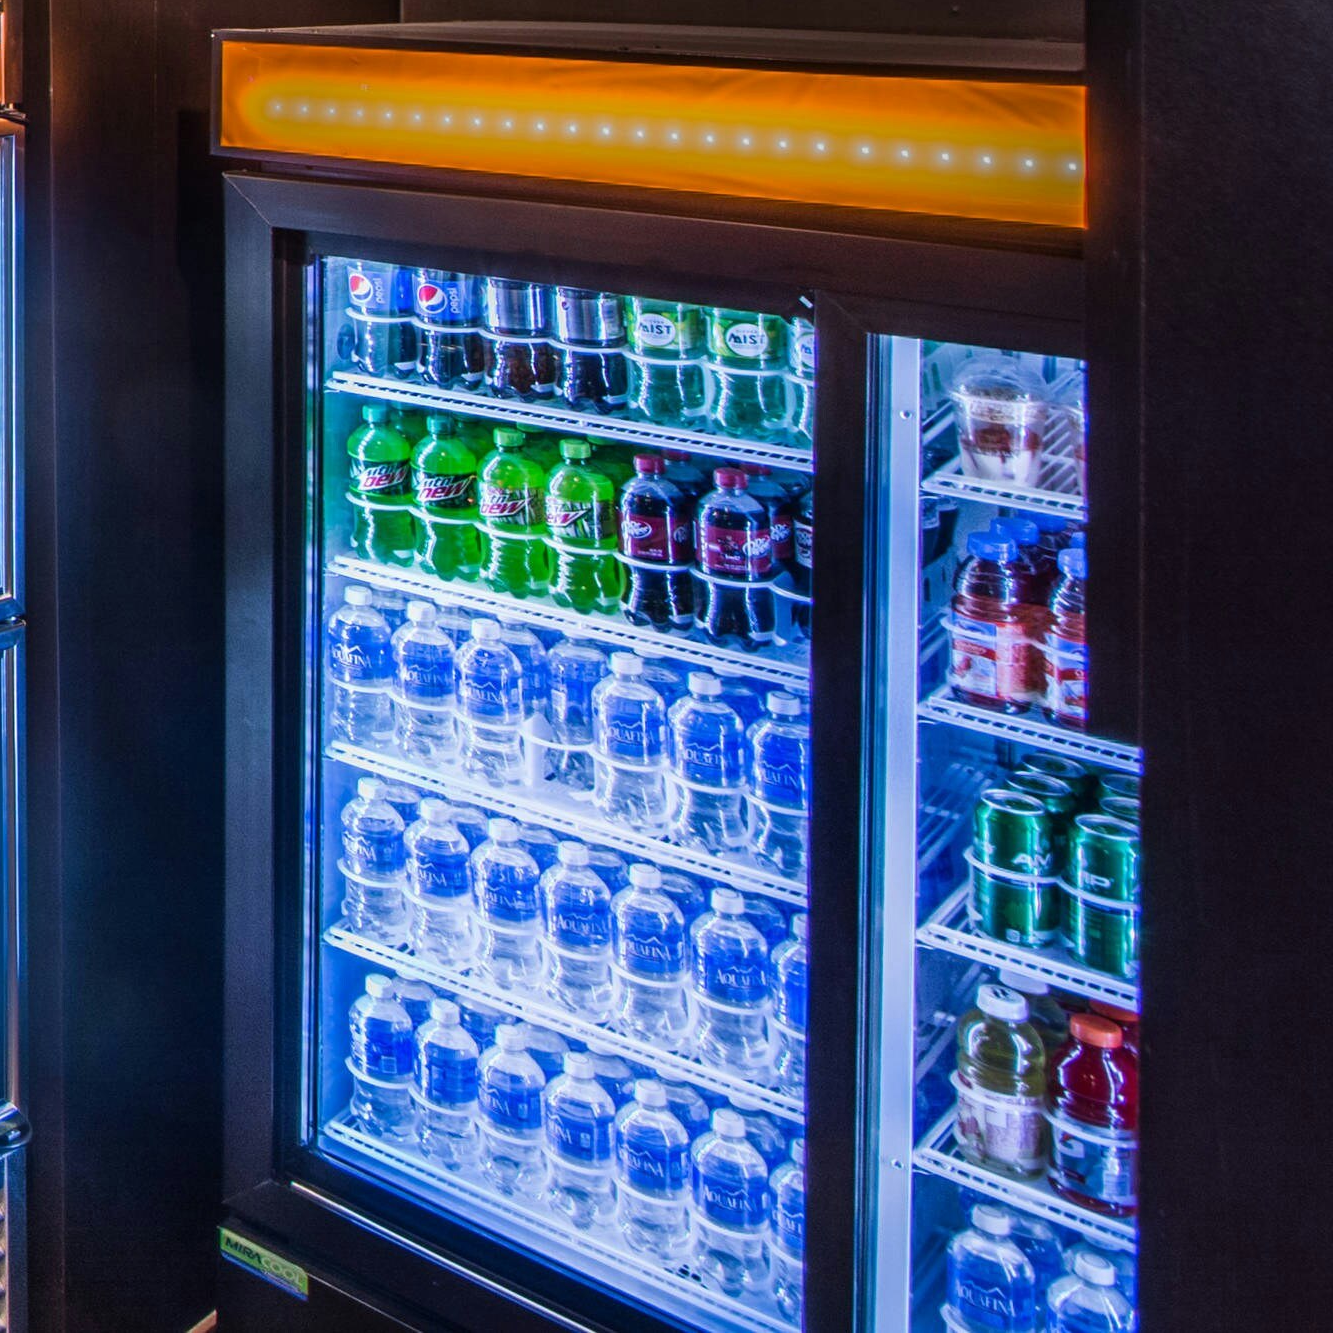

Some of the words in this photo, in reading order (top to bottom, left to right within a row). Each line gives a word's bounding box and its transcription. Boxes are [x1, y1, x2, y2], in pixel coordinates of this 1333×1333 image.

[450, 287, 458, 314] pepsi
[716, 969, 767, 986] AQUAFINA
[225, 1237, 302, 1286] MIRACOOL
[957, 1279, 1015, 1316] AQUAFINA
